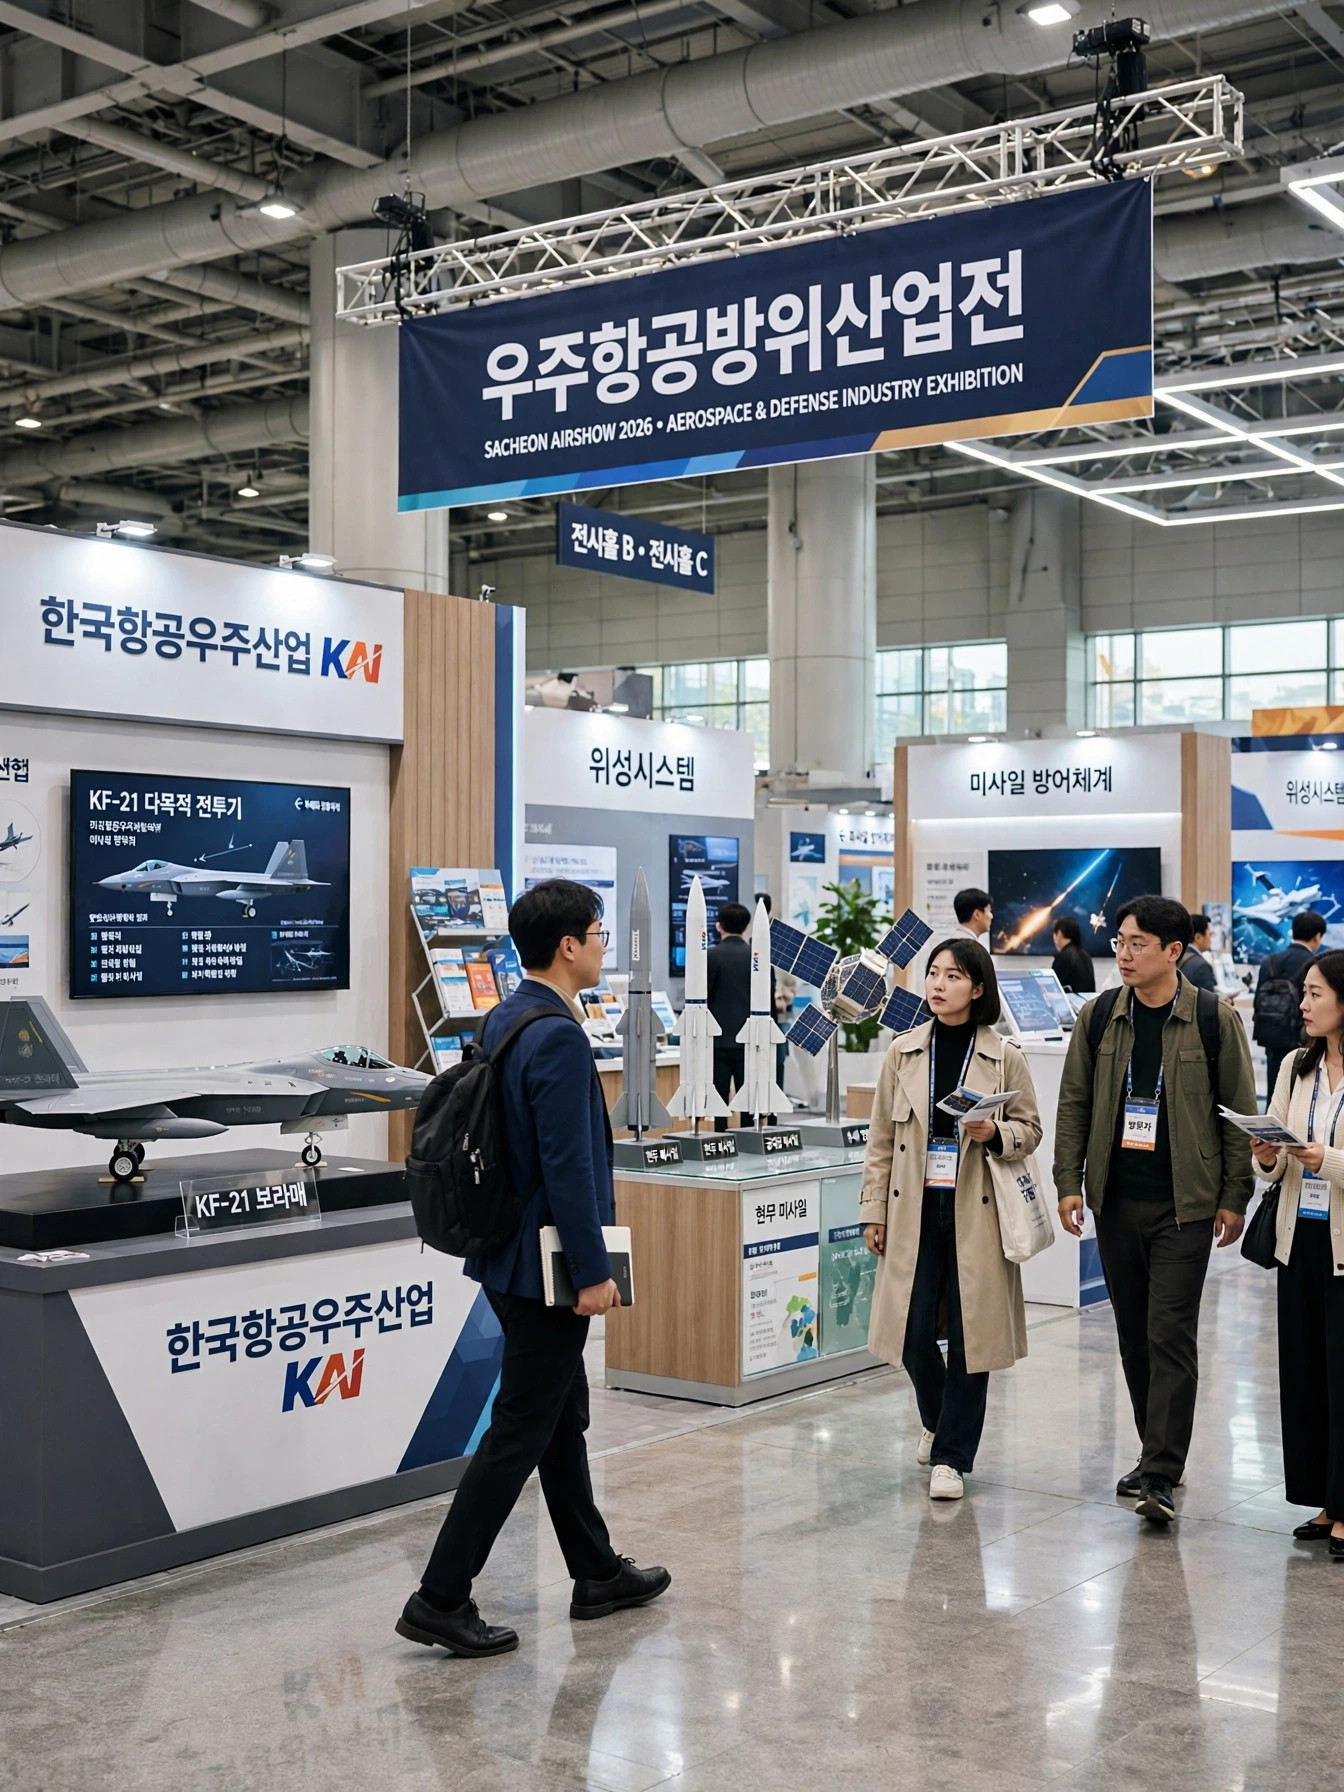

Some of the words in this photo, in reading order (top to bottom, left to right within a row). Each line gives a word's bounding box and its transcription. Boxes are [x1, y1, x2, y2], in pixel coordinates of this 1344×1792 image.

[482, 248, 1025, 423] 우주항공방위산업전
[484, 432, 548, 459] SACHEON
[550, 422, 616, 450] AIRSHOW
[619, 416, 653, 440] 2026
[666, 402, 752, 433] AEROSPACE
[755, 400, 767, 420] &
[770, 389, 838, 418] DEFENSE
[842, 377, 923, 407] INDUSTRY
[926, 362, 1024, 396] EXHIBITION
[571, 522, 620, 561] 전시홀
[622, 533, 635, 562] B
[649, 539, 694, 576] 전시홀
[695, 550, 708, 577] C
[40, 595, 311, 676] 한국항공우주산업
[320, 636, 383, 684] KAI
[589, 747, 695, 792] 위성시스템
[970, 769, 1025, 797] 미사일
[1033, 765, 1112, 795] 방어체계
[89, 789, 138, 812] KF-21
[144, 791, 191, 817] 다목적
[196, 794, 242, 820] 전투기
[195, 1189, 250, 1218] KF-21
[255, 1181, 308, 1209] 보라매
[755, 1203, 776, 1225] 현무
[779, 1198, 807, 1220] 미사일
[166, 1280, 433, 1374] 한국항공우주산업
[281, 1347, 366, 1413] KAI
